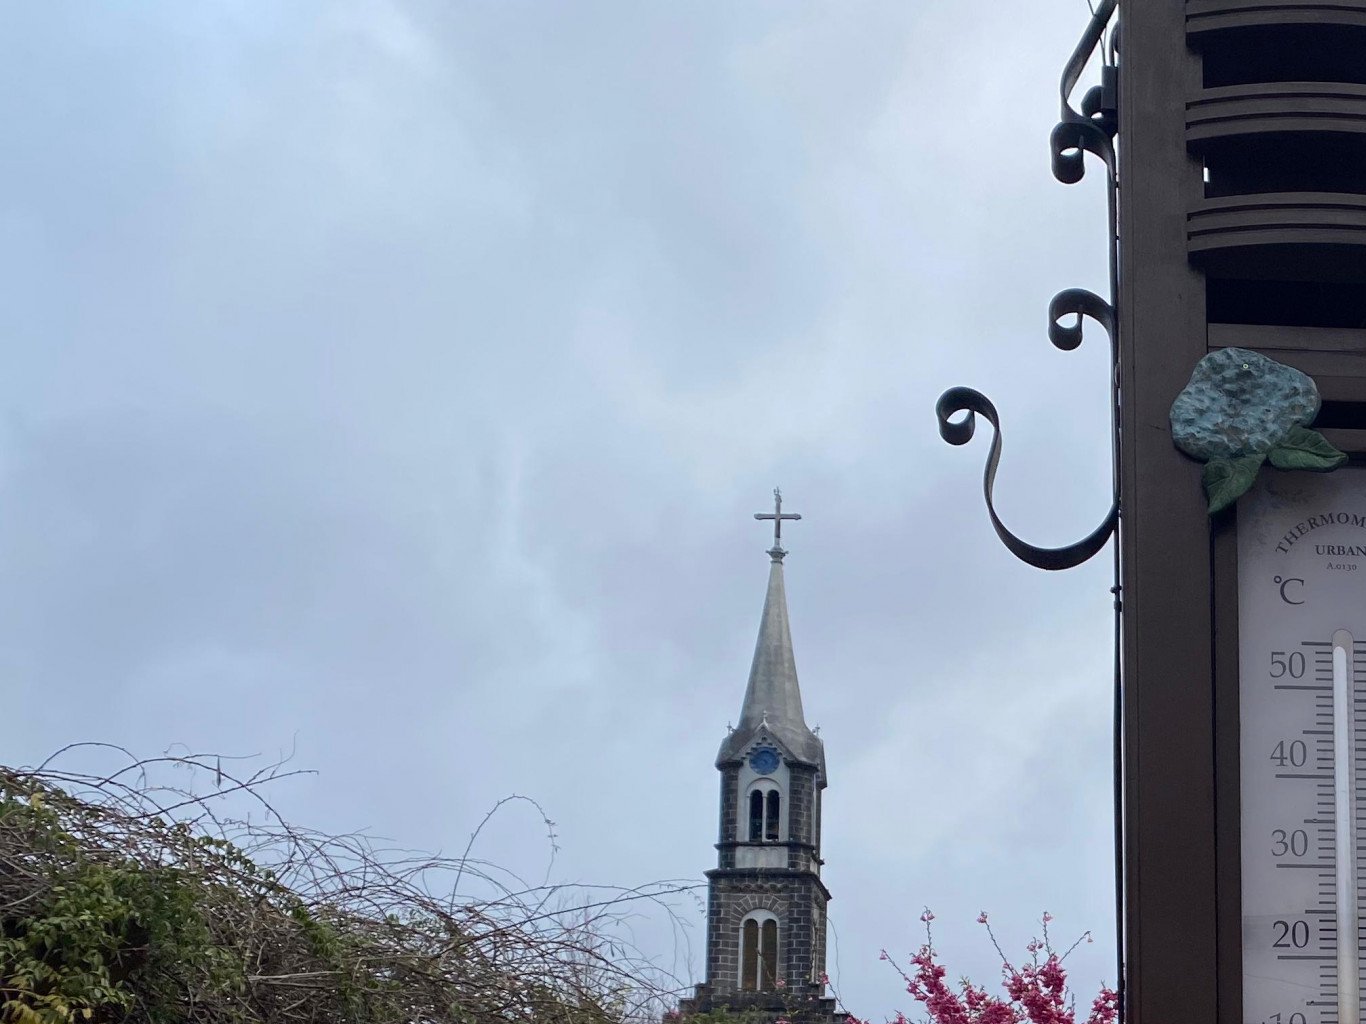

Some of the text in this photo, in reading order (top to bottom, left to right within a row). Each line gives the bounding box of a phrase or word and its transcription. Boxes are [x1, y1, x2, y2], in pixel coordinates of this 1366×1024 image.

[1315, 544, 1366, 556] URBAN
[1269, 651, 1306, 679] 50
[1270, 740, 1307, 767] 40
[1271, 829, 1308, 857] 30
[1272, 920, 1310, 948] 20
